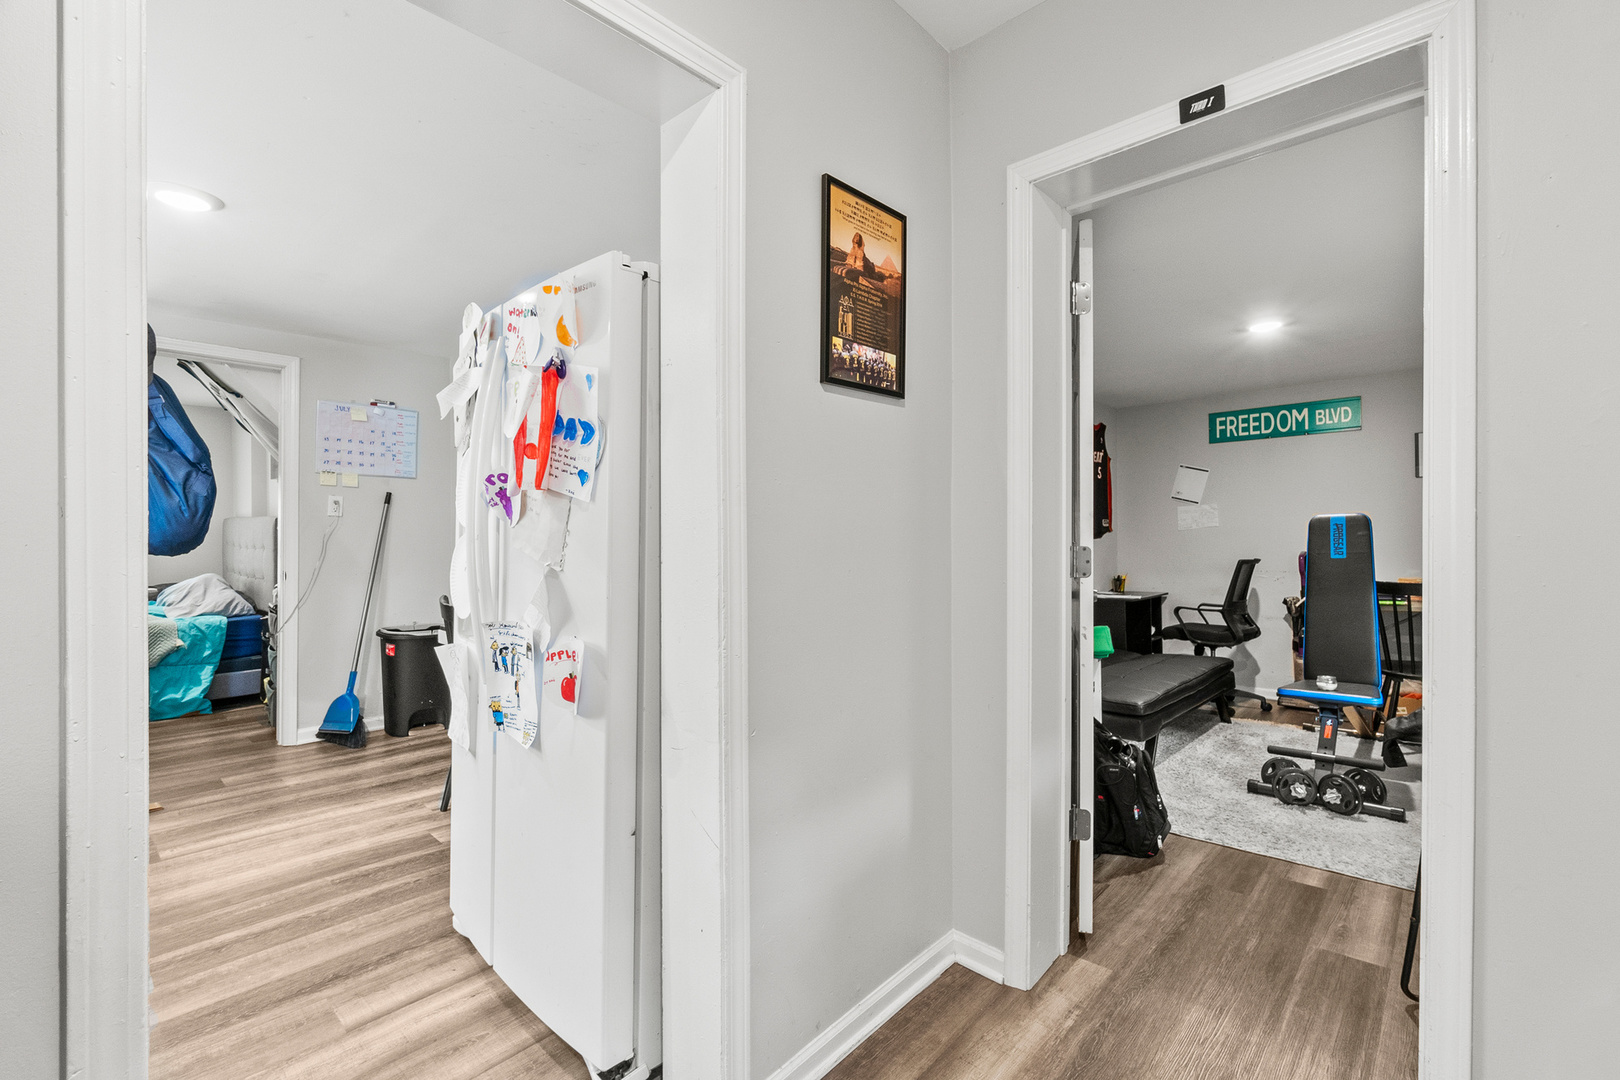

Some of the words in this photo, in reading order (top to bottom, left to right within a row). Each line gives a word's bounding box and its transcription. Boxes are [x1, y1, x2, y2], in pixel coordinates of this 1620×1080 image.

[1216, 407, 1309, 439] FREEDOM
[1315, 406, 1352, 426] BLVD
[1093, 451, 1104, 463] EAT
